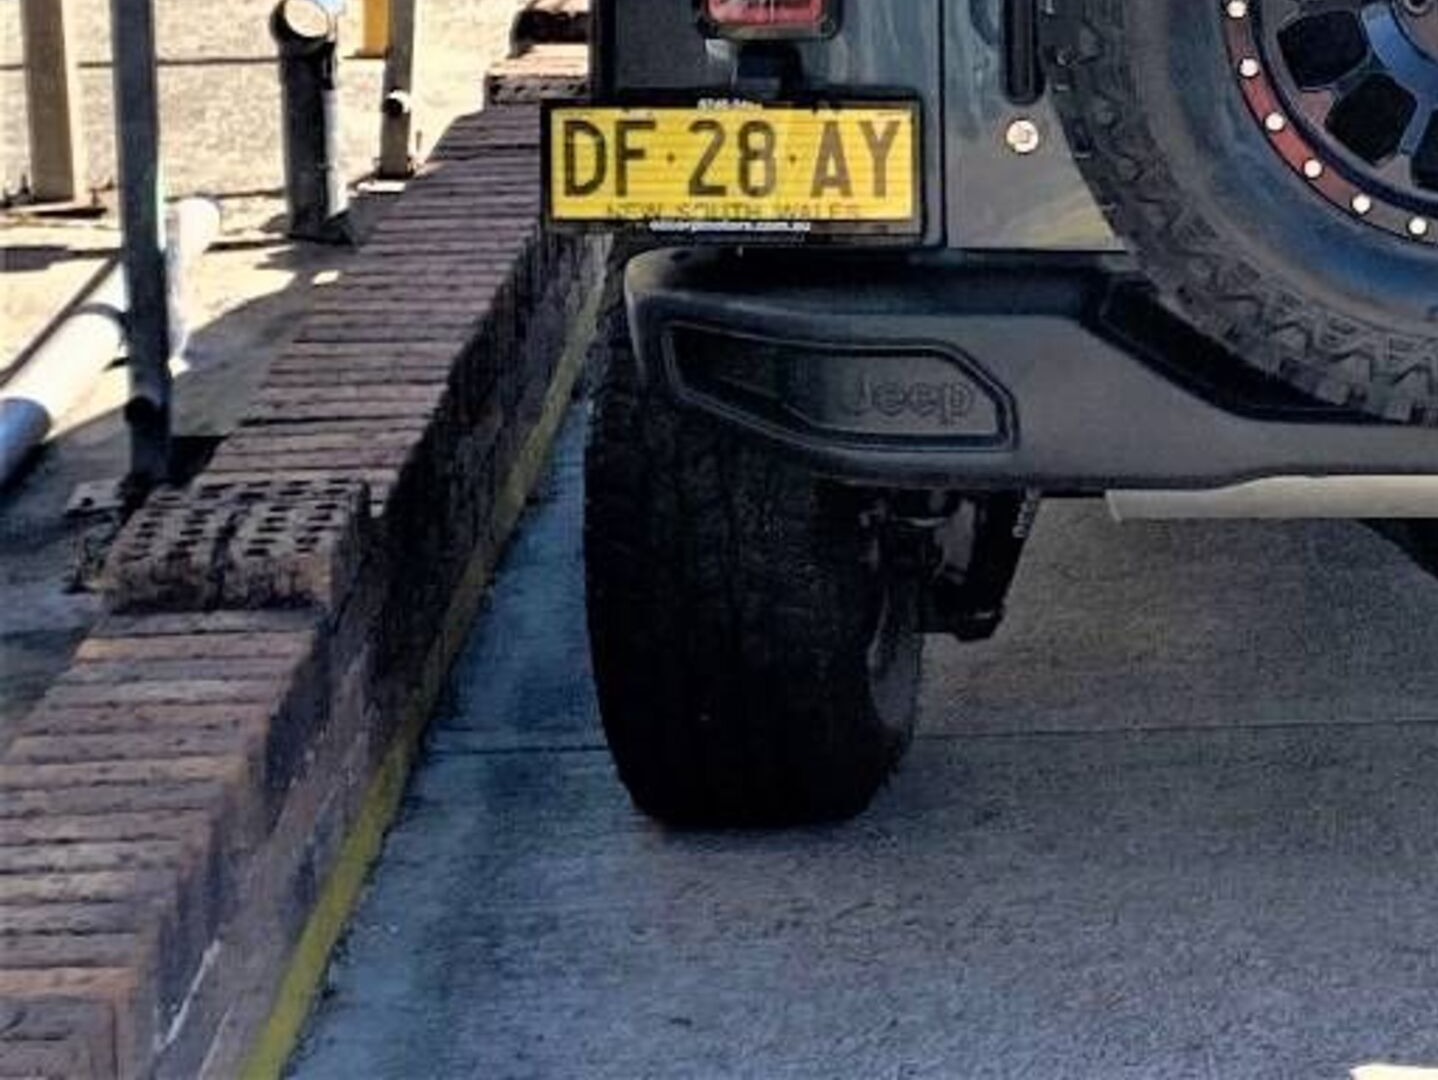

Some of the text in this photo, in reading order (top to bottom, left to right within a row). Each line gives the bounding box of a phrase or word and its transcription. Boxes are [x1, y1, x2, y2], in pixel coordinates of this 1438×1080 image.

[562, 119, 901, 198] DF 28 AY
[607, 202, 861, 219] NEW SOUTH WALES
[851, 371, 976, 426] Jeep
